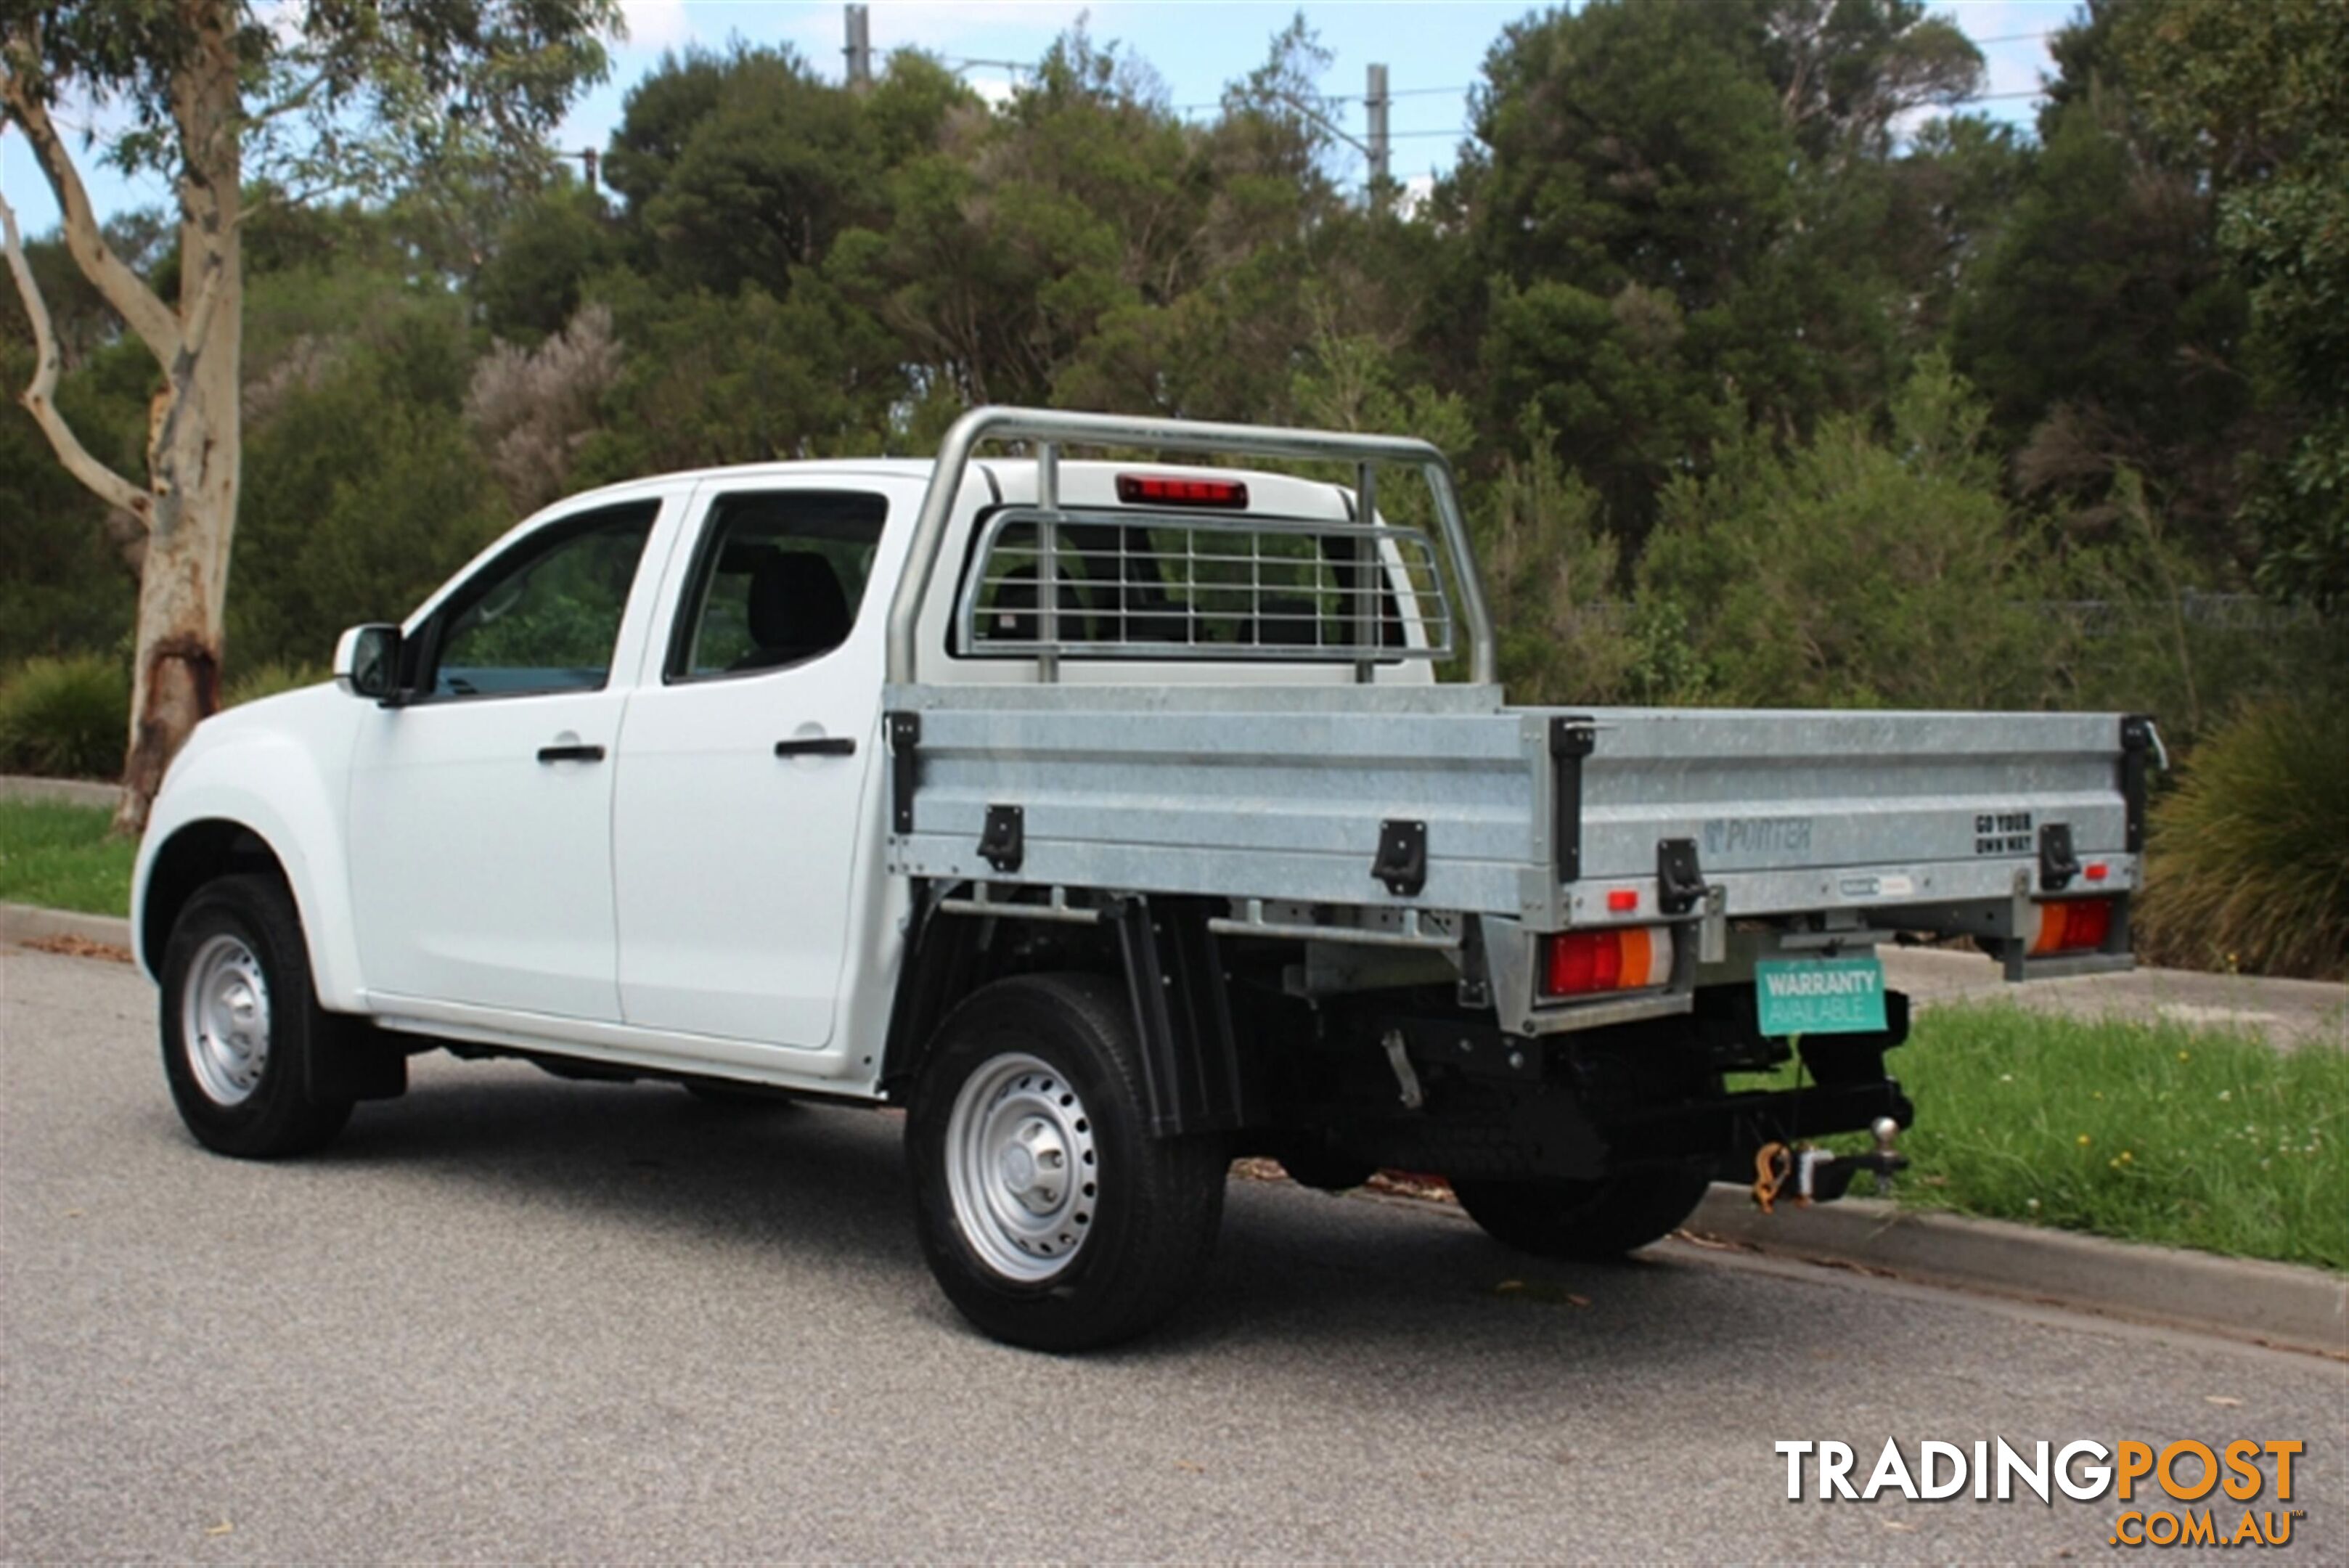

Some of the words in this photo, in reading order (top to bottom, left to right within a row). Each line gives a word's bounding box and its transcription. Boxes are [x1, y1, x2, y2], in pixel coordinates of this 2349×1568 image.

[1975, 814, 1993, 833] GO
[1997, 812, 2032, 832] YOUR
[1975, 837, 2003, 854] OWN
[2007, 835, 2032, 851] WAY
[1765, 970, 1876, 997] WARRANTY
[1769, 997, 1866, 1024] AVAILABLE
